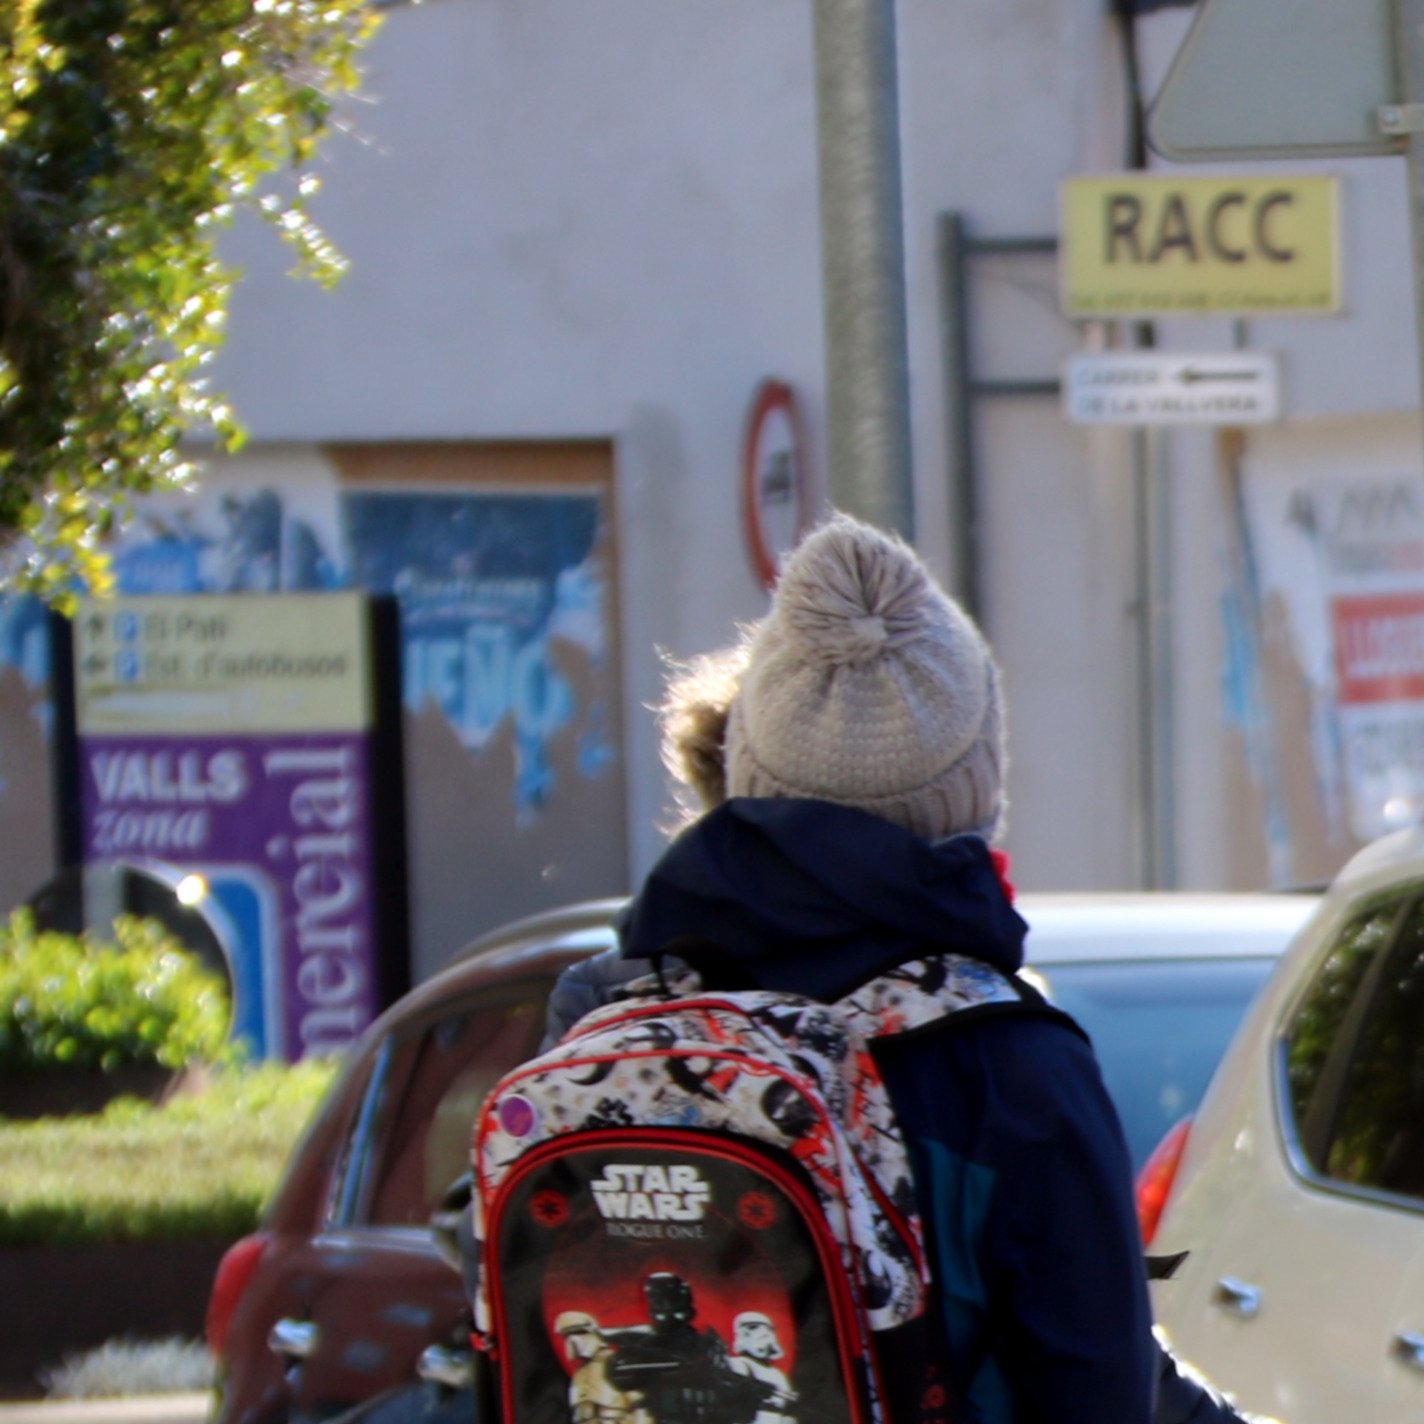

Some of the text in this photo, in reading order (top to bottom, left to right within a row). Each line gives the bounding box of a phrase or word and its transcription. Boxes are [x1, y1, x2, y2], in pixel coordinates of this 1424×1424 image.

[1103, 189, 1297, 265] RACC
[1077, 368, 1160, 386] CARRER
[1111, 397, 1138, 413] LA
[90, 749, 247, 802] VALLS
[92, 808, 209, 851] zona
[589, 1163, 711, 1193] STAR
[592, 1191, 712, 1222] WARS
[605, 1221, 704, 1240] ROGUE ONE
